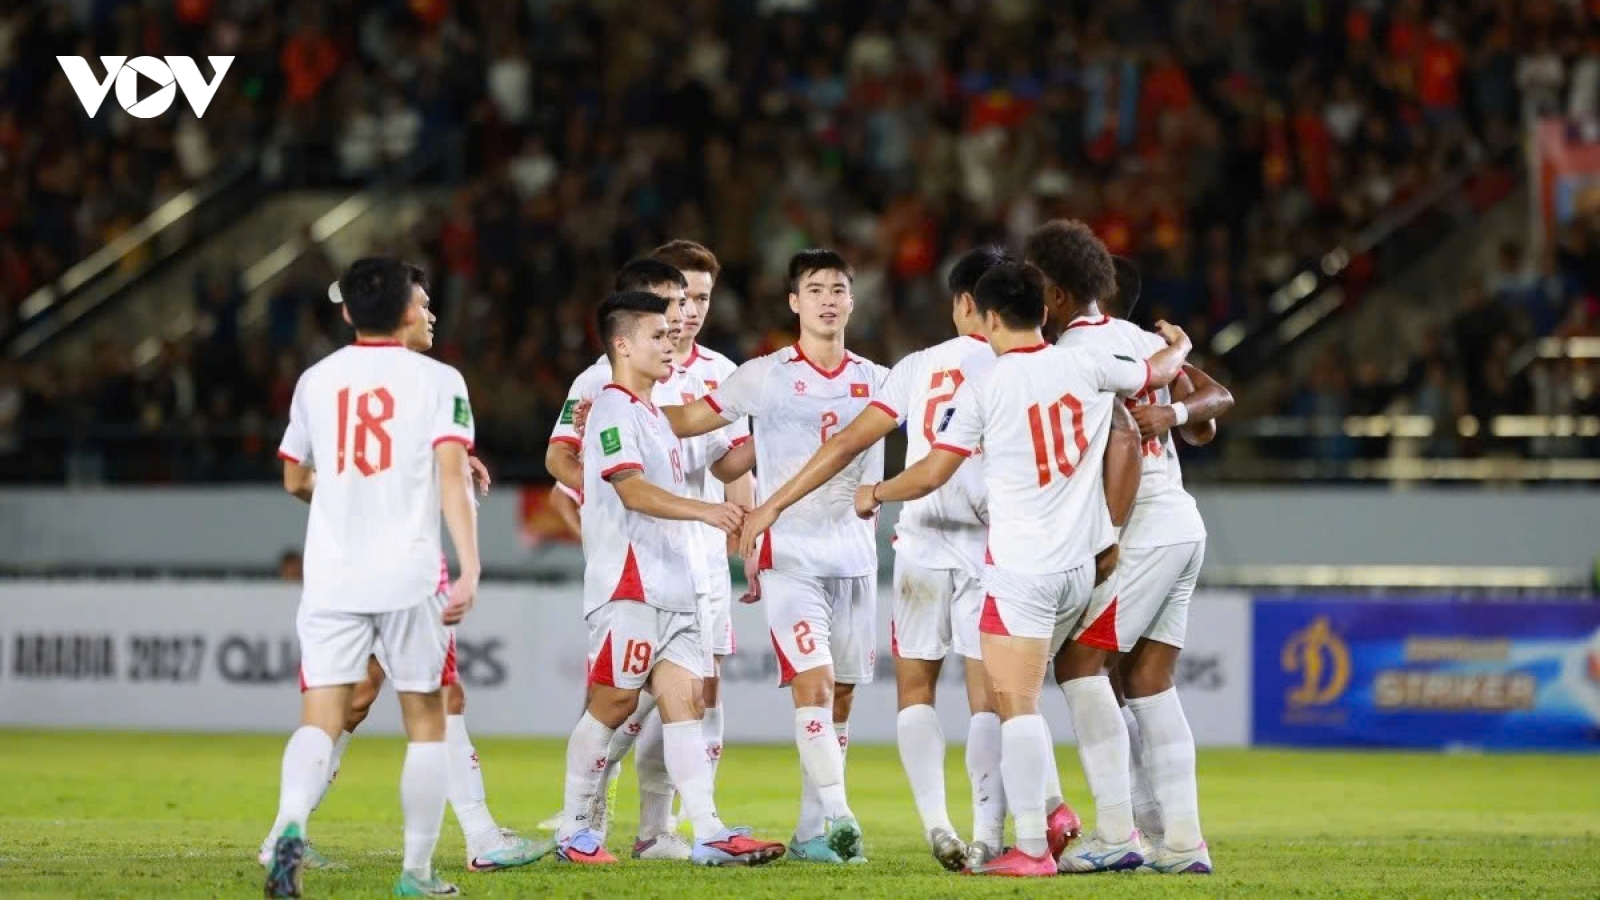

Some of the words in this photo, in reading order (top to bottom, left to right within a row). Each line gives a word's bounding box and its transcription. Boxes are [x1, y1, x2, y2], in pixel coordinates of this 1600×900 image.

[337, 387, 395, 477] 18
[820, 411, 838, 446] 2
[1028, 393, 1089, 488] 10
[127, 633, 206, 684] 2027
[622, 639, 652, 675] 19
[793, 620, 816, 656] 2
